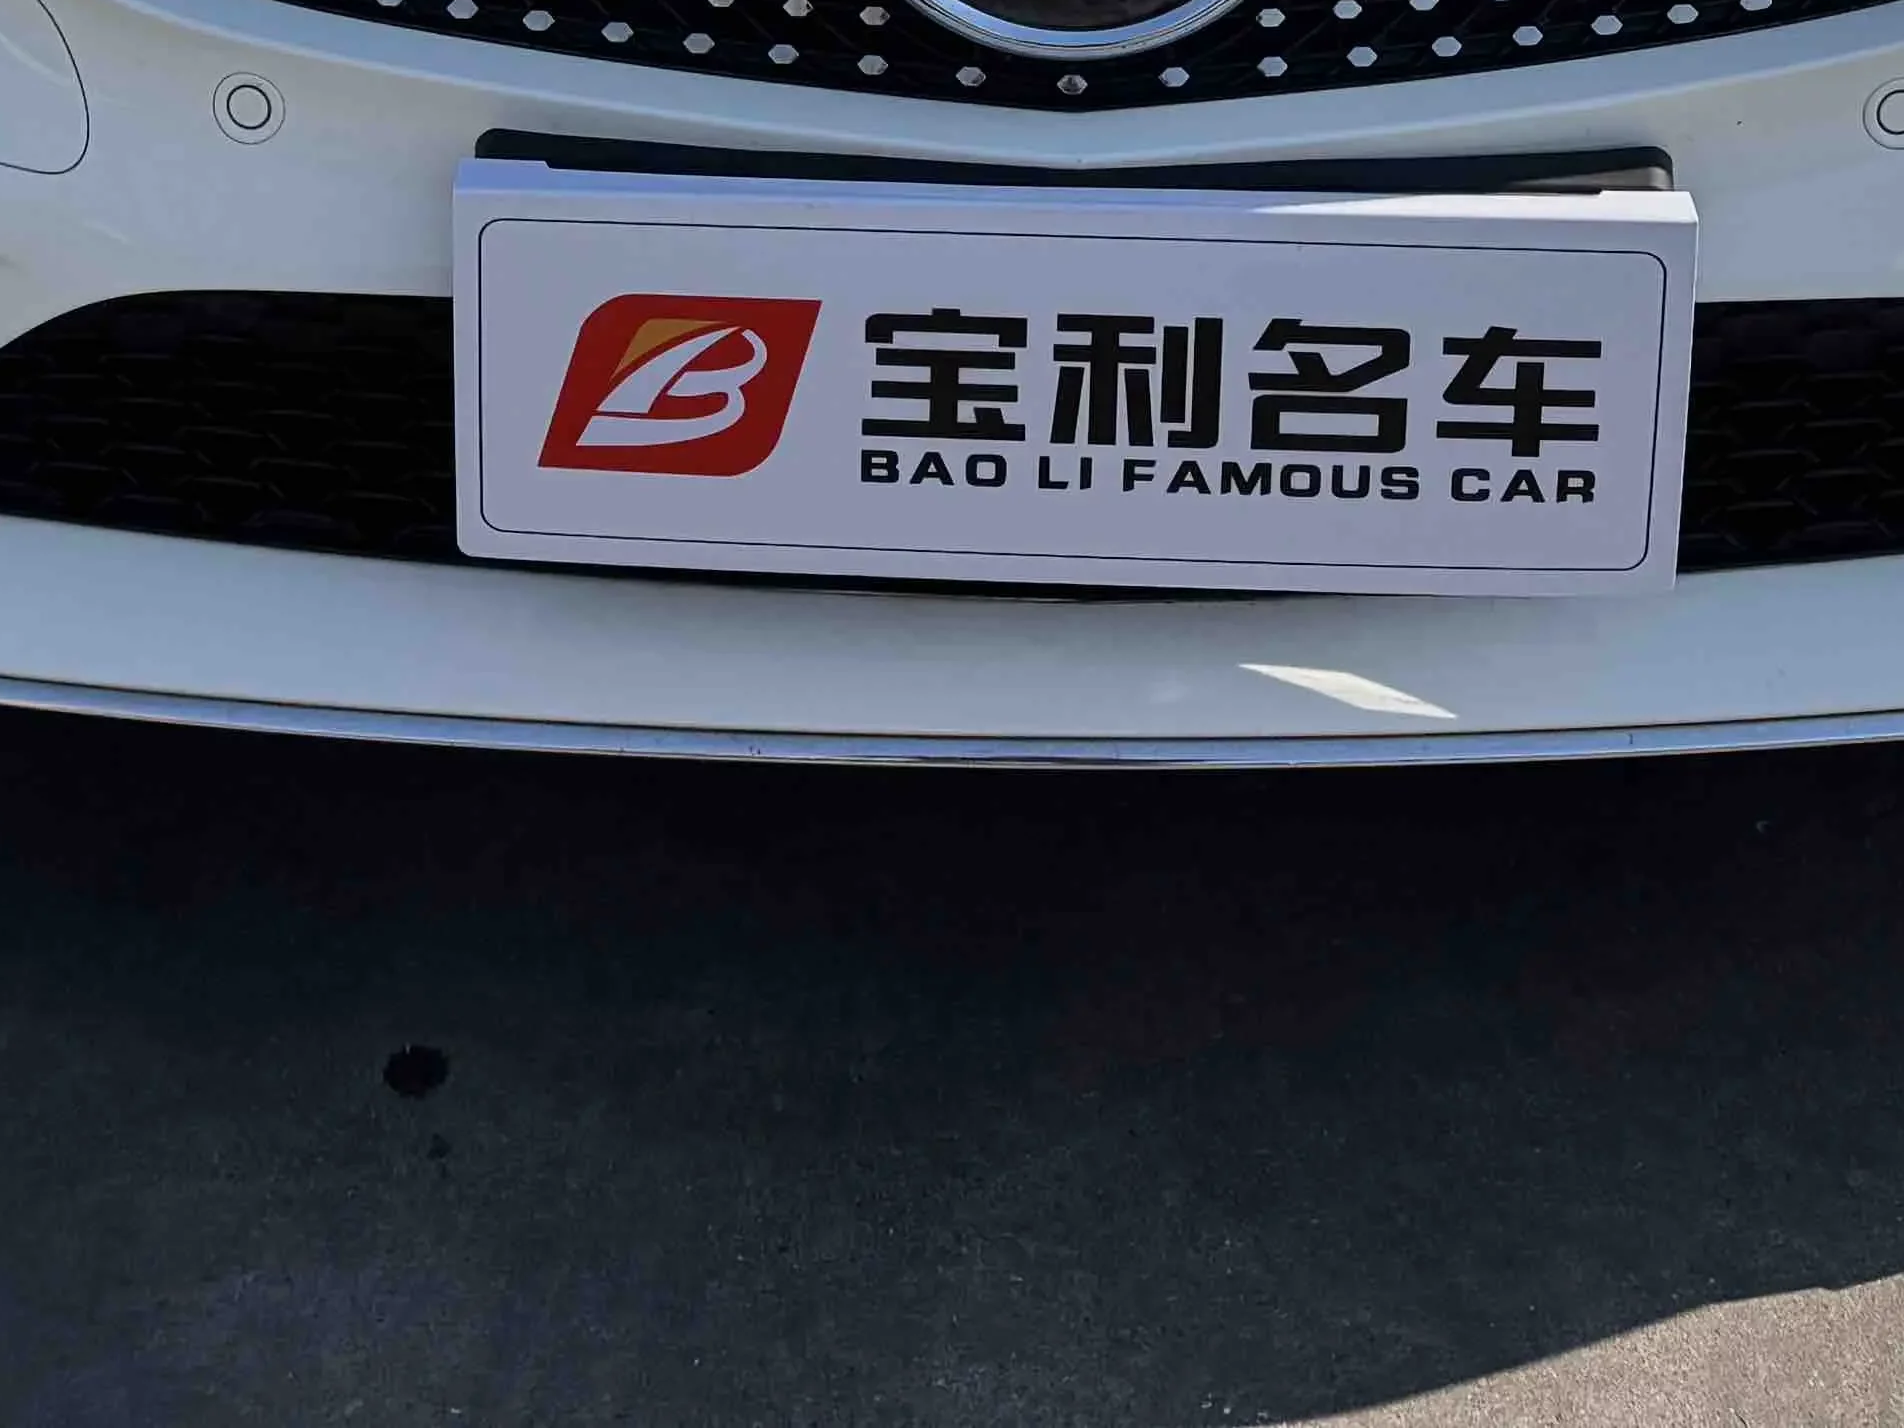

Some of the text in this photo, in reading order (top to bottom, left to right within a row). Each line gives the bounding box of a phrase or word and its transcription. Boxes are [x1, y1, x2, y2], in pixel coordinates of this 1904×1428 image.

[861, 307, 1603, 459] 宝利名车
[860, 449, 1597, 505] BAO LI FAMOUS CAR
